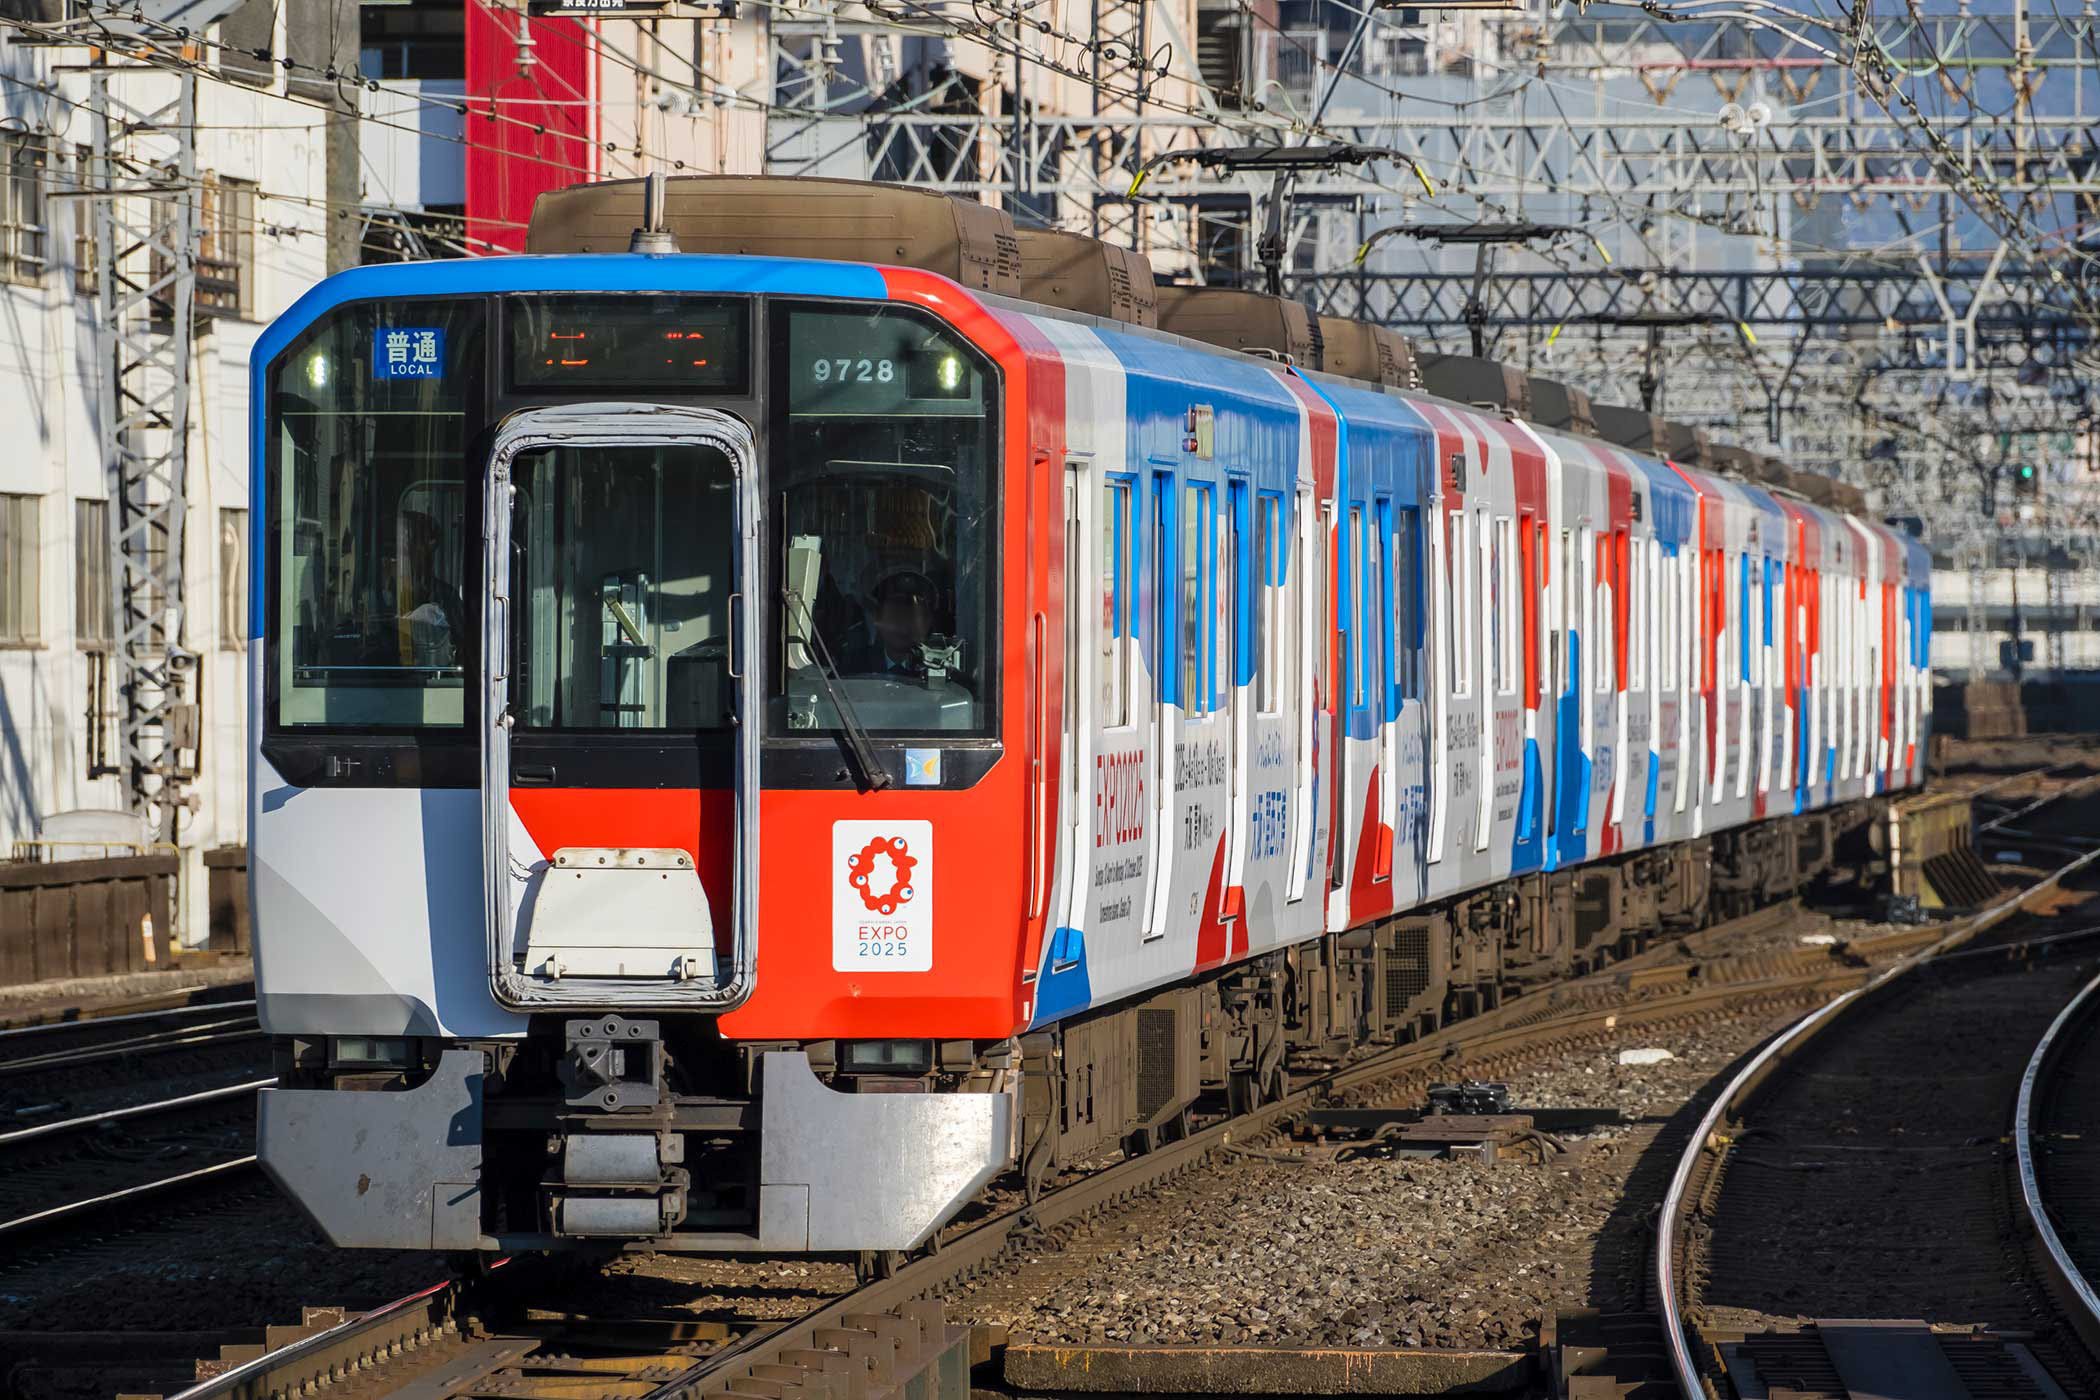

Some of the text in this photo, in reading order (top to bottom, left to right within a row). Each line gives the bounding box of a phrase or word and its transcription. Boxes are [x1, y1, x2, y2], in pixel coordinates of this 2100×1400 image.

[386, 331, 438, 363] 普通
[391, 364, 433, 375] LOCAL
[814, 359, 894, 382] 9728
[1096, 750, 1144, 848] EXPO2025
[859, 926, 908, 940] EXPO
[859, 942, 907, 956] 2025
